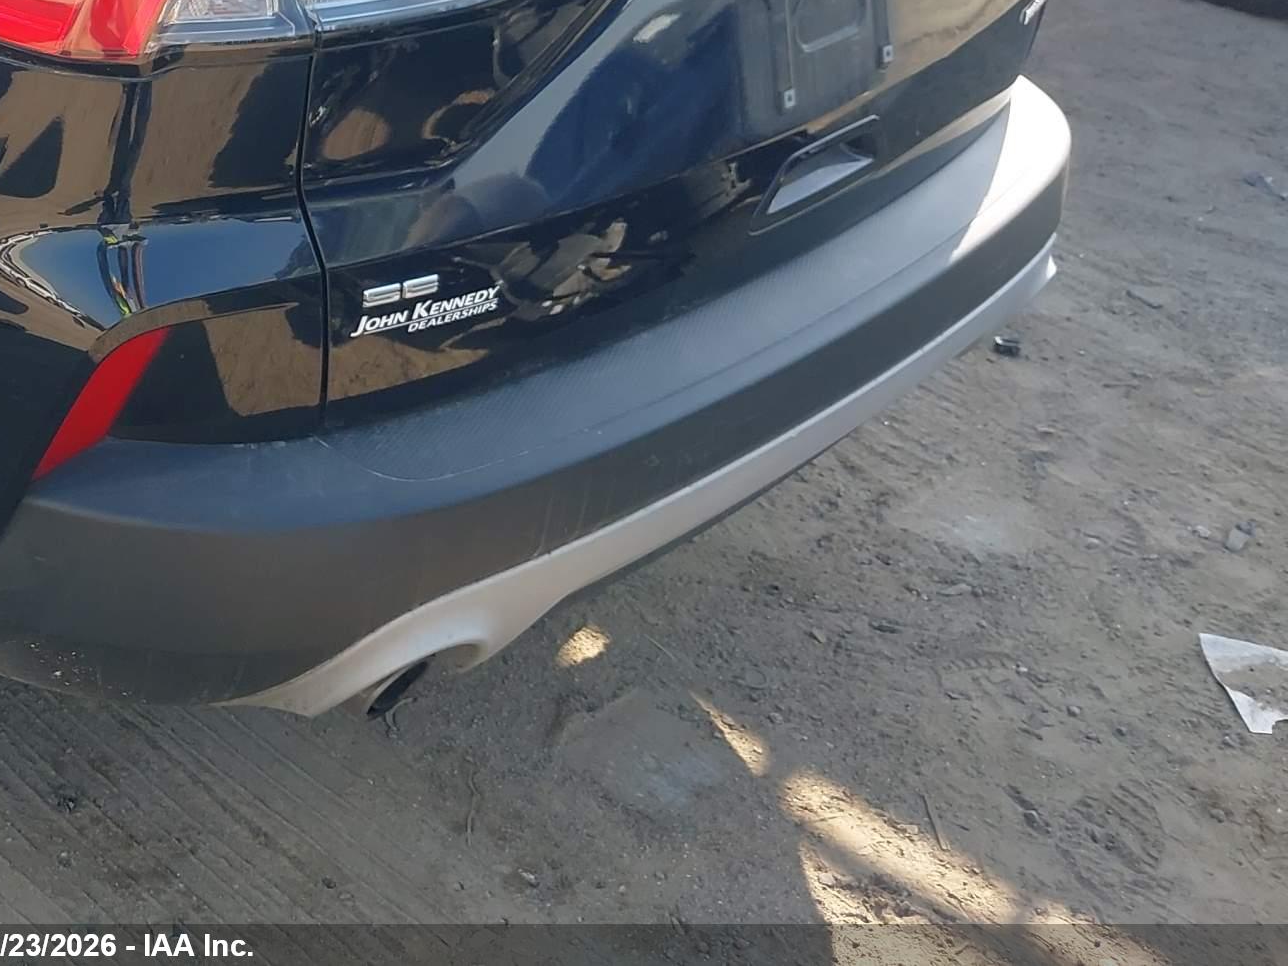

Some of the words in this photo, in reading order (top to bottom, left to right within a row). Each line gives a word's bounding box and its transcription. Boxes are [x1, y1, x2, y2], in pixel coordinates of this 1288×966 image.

[362, 273, 440, 308] SE
[350, 310, 409, 338] JOHN
[412, 285, 500, 320] KENNEDY
[407, 300, 499, 333] DEALERSHIPS
